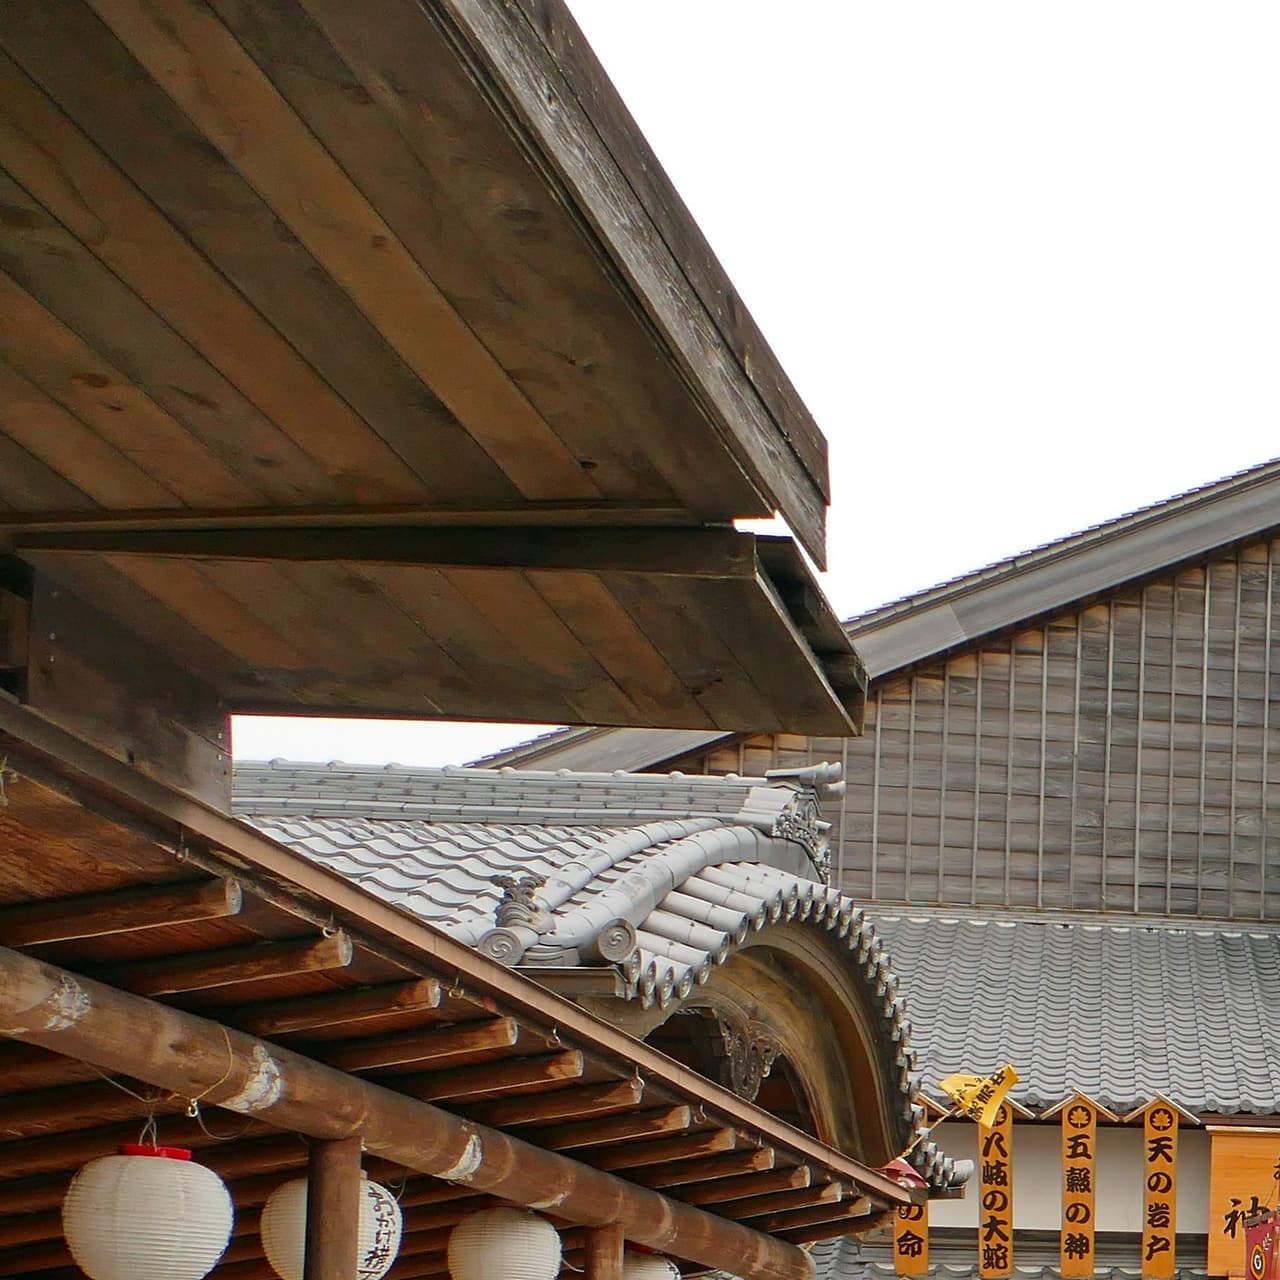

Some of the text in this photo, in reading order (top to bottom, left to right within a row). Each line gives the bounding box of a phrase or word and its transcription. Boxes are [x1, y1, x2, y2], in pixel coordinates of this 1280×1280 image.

[982, 1132, 1010, 1270] 八岐の大蛇
[1144, 1136, 1174, 1261] 天の岩戸
